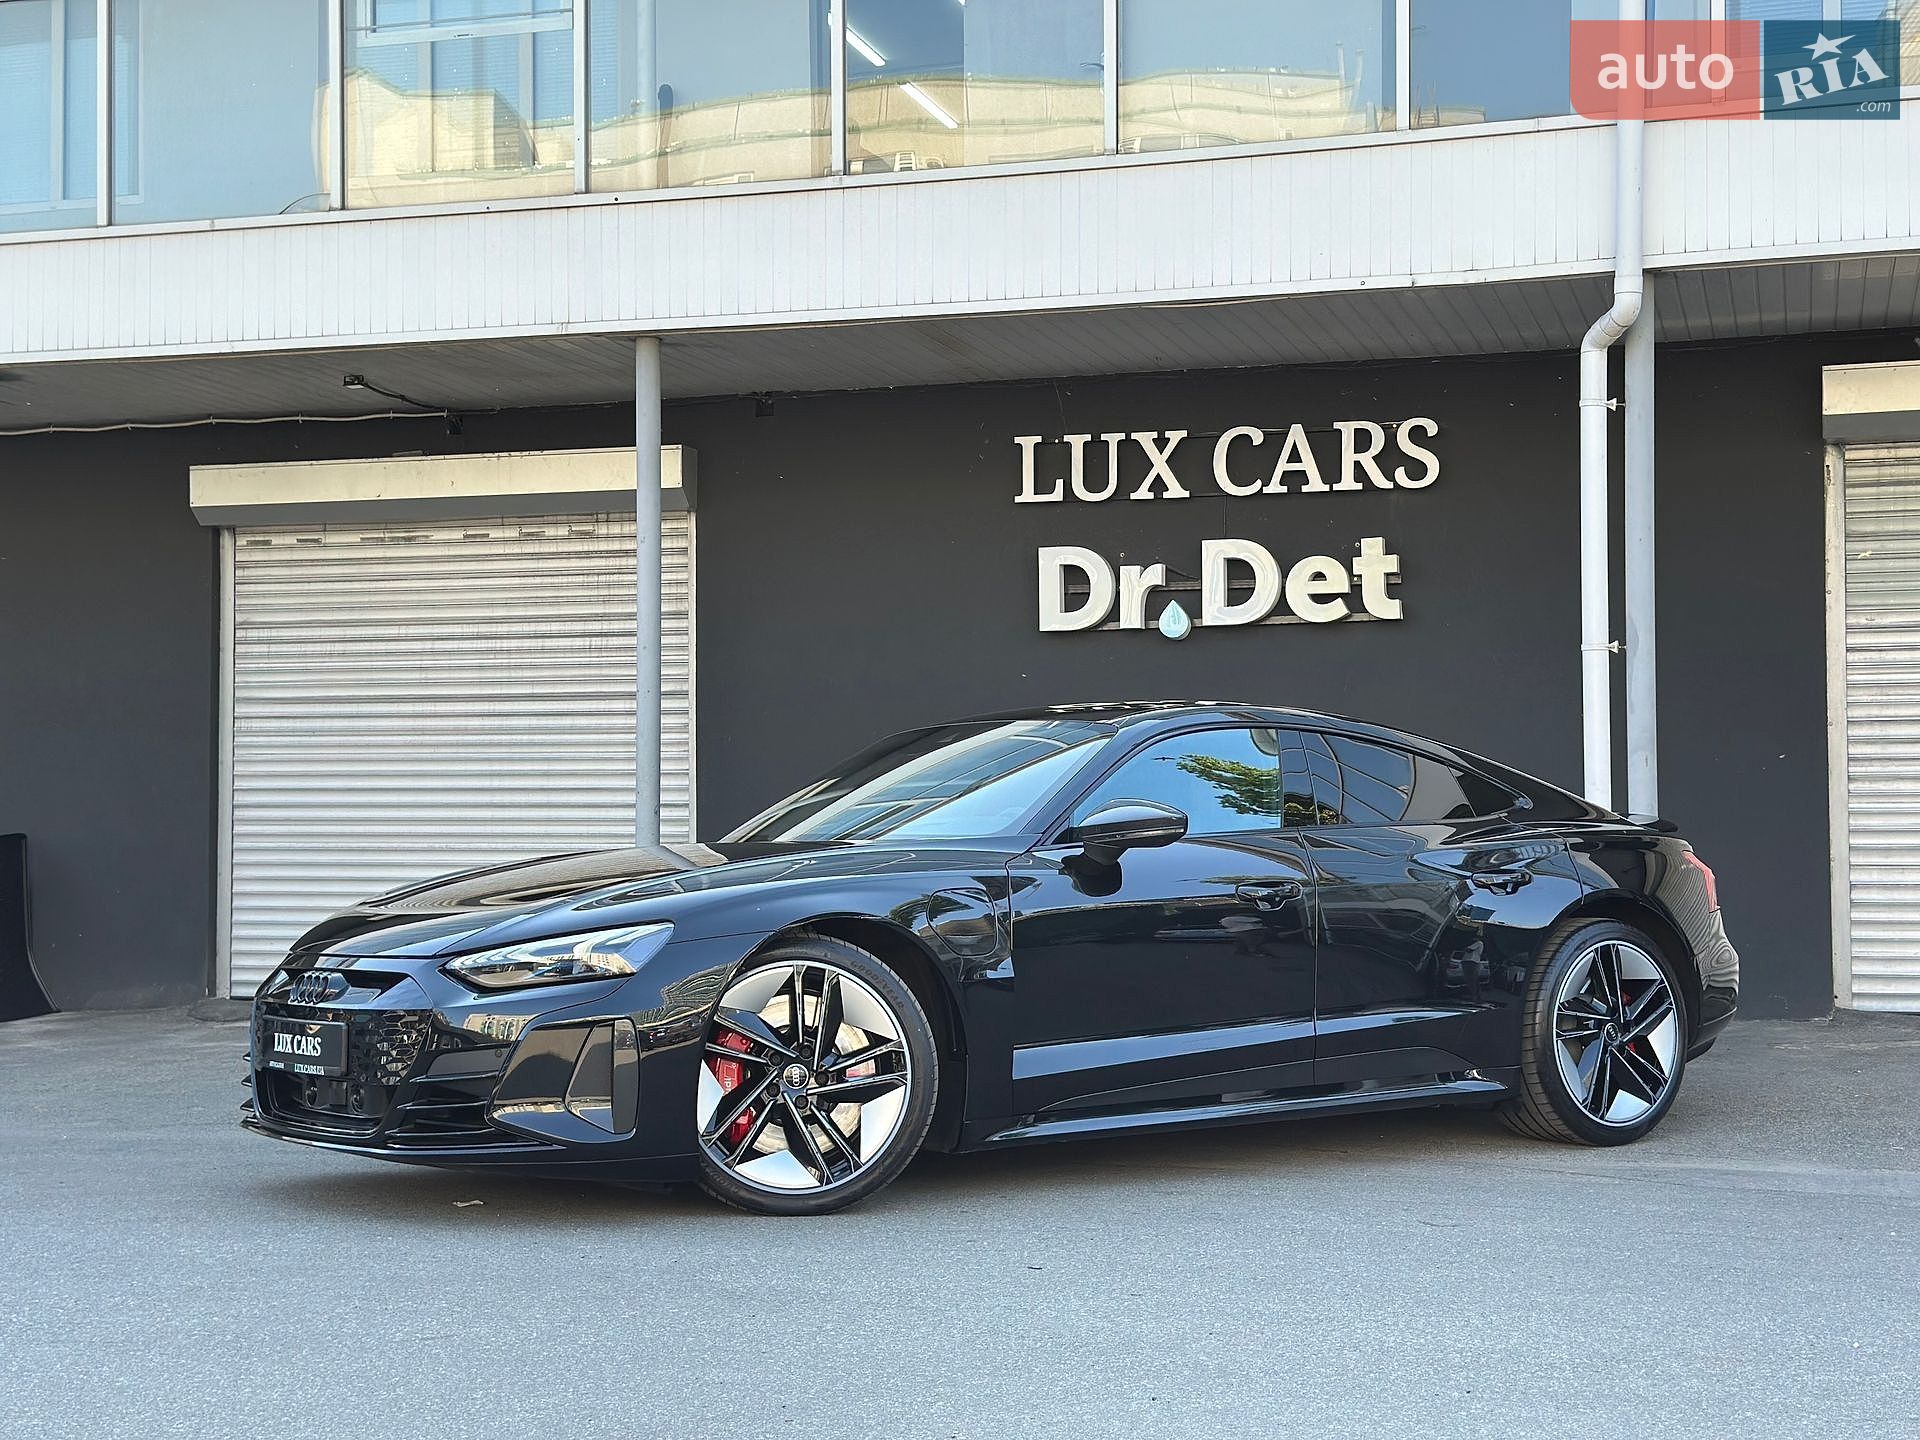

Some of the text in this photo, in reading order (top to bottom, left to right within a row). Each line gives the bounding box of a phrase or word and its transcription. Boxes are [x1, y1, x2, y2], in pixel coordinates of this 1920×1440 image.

[1013, 417, 1441, 503] LUX CARS
[273, 1032, 322, 1057] LUX CARS
